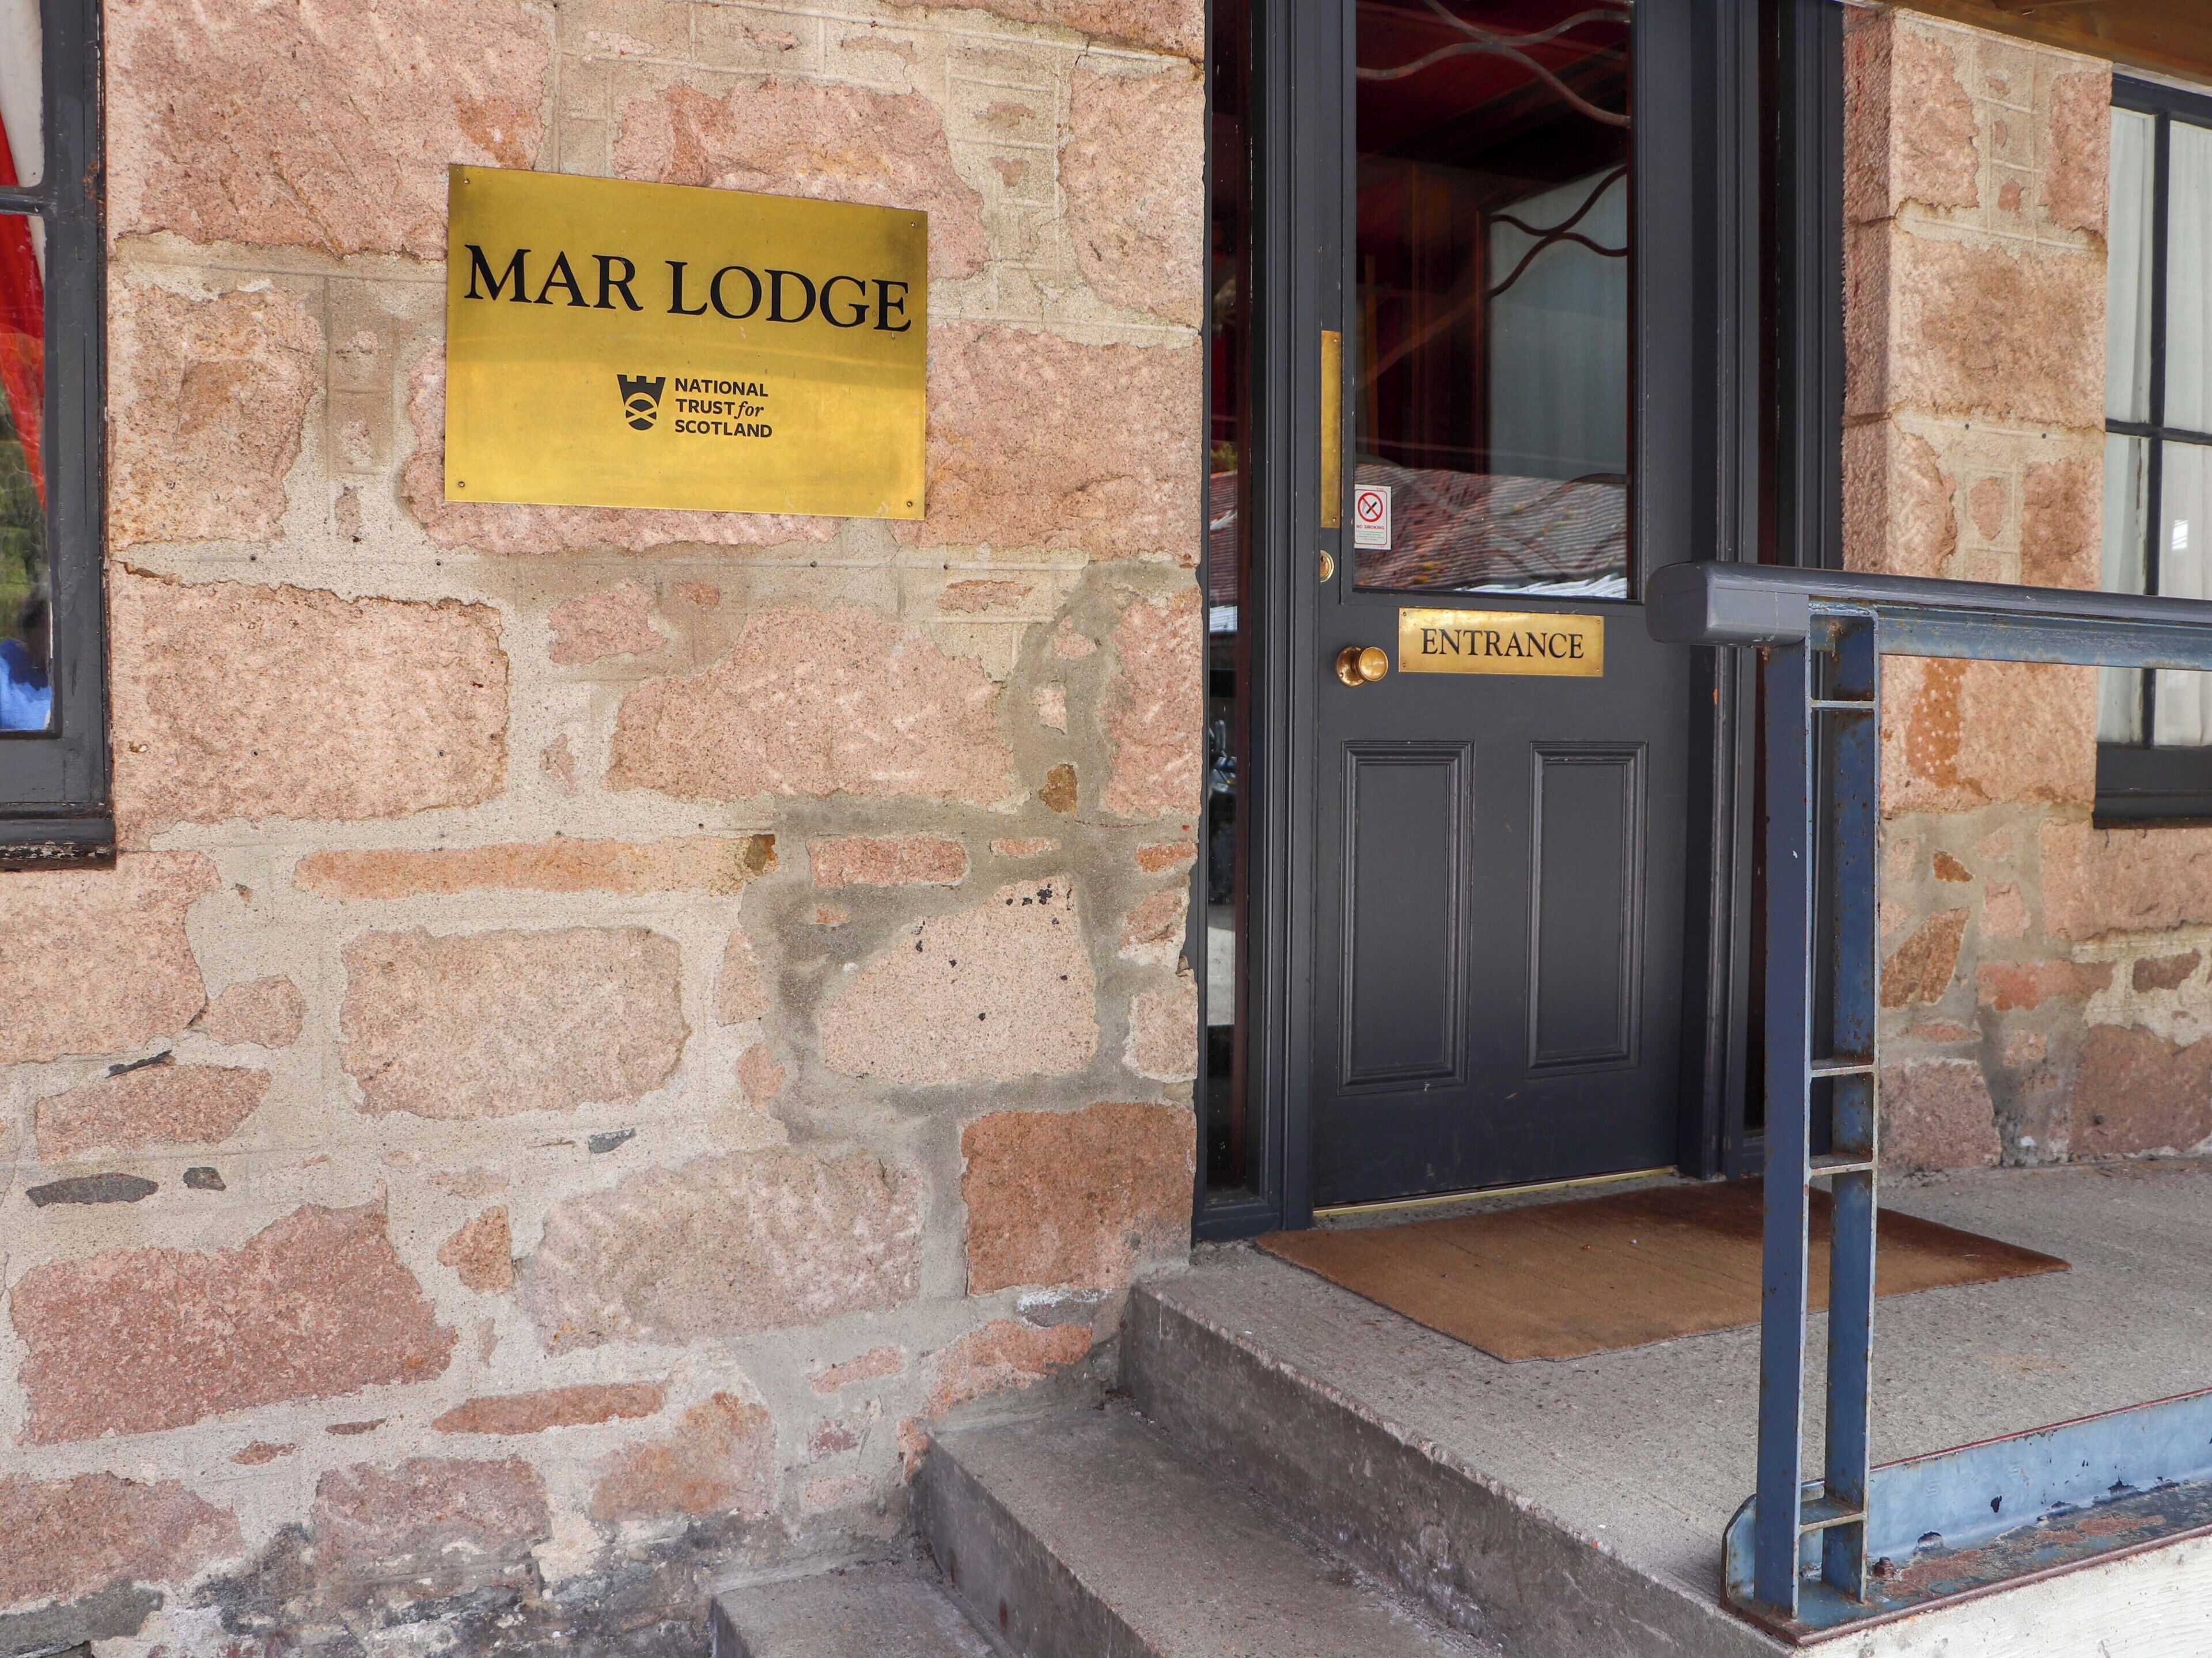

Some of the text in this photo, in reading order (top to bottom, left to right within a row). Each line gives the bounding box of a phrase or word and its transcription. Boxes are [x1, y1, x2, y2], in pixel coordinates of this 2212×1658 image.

[463, 244, 912, 332] MAR LODGE
[675, 378, 769, 397] NATIONAL
[675, 399, 764, 419] TRUST for
[675, 419, 773, 438] SCOTLAND
[1421, 628, 1584, 659] ENTRANCE
